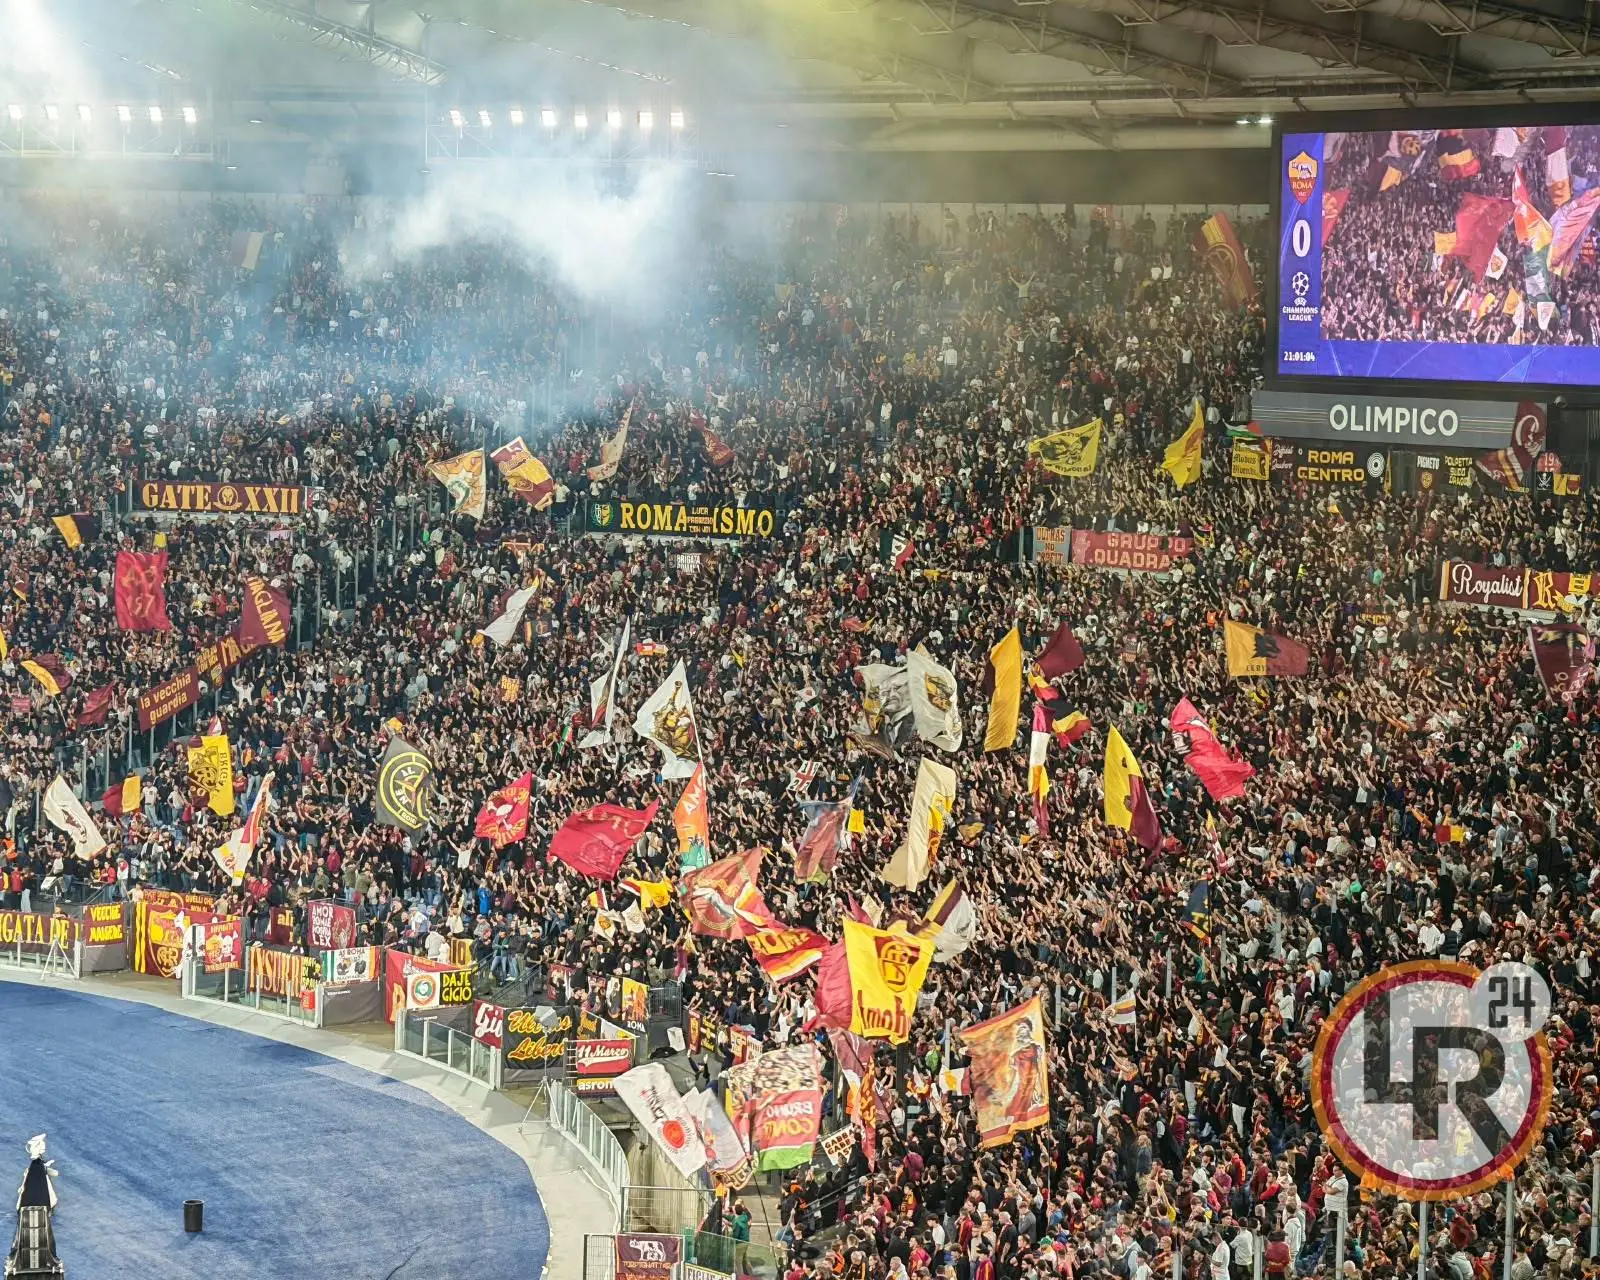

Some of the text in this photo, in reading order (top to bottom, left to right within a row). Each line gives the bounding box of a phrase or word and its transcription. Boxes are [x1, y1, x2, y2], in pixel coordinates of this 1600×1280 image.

[1292, 181, 1313, 190] ROMA
[1292, 219, 1311, 258] 0
[1282, 306, 1319, 315] CHAMPIONS
[1288, 314, 1313, 322] LEAGUE
[1283, 351, 1316, 362] 21:01:04
[1329, 403, 1459, 437] OLIMPICO
[1307, 450, 1354, 465] ROMA
[1297, 466, 1365, 482] CENTRO
[142, 482, 300, 514] GATE XXII
[620, 502, 774, 538] ROMA ISMO
[1451, 562, 1523, 604] Royalist
[140, 672, 192, 710] la vecchia
[149, 691, 188, 727] guardia
[443, 970, 472, 988] DAJE
[442, 986, 472, 1002] GIGIO
